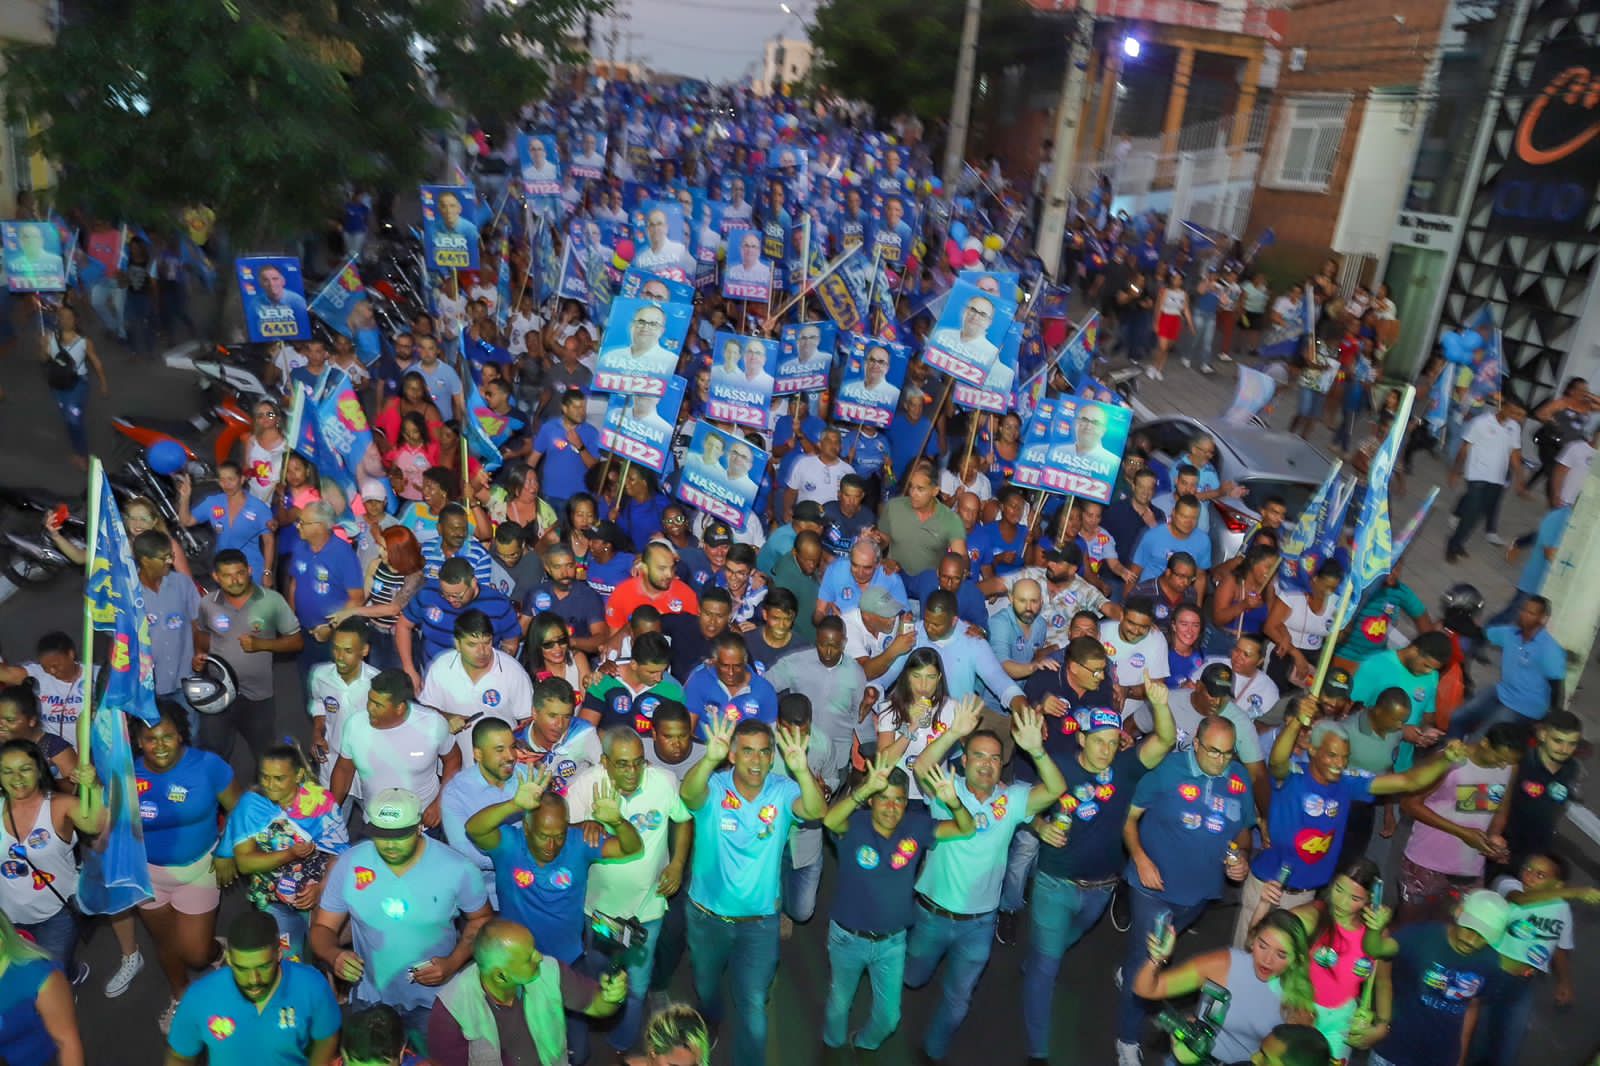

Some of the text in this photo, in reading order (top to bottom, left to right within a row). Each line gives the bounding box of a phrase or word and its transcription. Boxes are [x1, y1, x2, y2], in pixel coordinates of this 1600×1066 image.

[432, 236, 468, 250] LEUR
[438, 252, 469, 265] 4411
[726, 284, 767, 298] 11122
[257, 306, 296, 320] LEUR
[263, 322, 297, 336] 4411
[605, 356, 667, 374] HASSAN
[780, 361, 826, 375] HASSAN
[928, 346, 984, 386] 11122
[599, 372, 664, 396] 11122
[715, 385, 764, 405] HASSAN
[776, 375, 825, 392] 11122
[843, 383, 895, 405] HASSAN
[959, 385, 1005, 410] 11122
[711, 401, 764, 426] 11122
[838, 402, 891, 425] 11122
[609, 411, 665, 445] HASSAN
[603, 429, 663, 468] 11122
[1051, 448, 1111, 477] HASSAN
[688, 471, 746, 508] HASSAN
[1045, 466, 1108, 499] 11122
[682, 483, 742, 527] 11122
